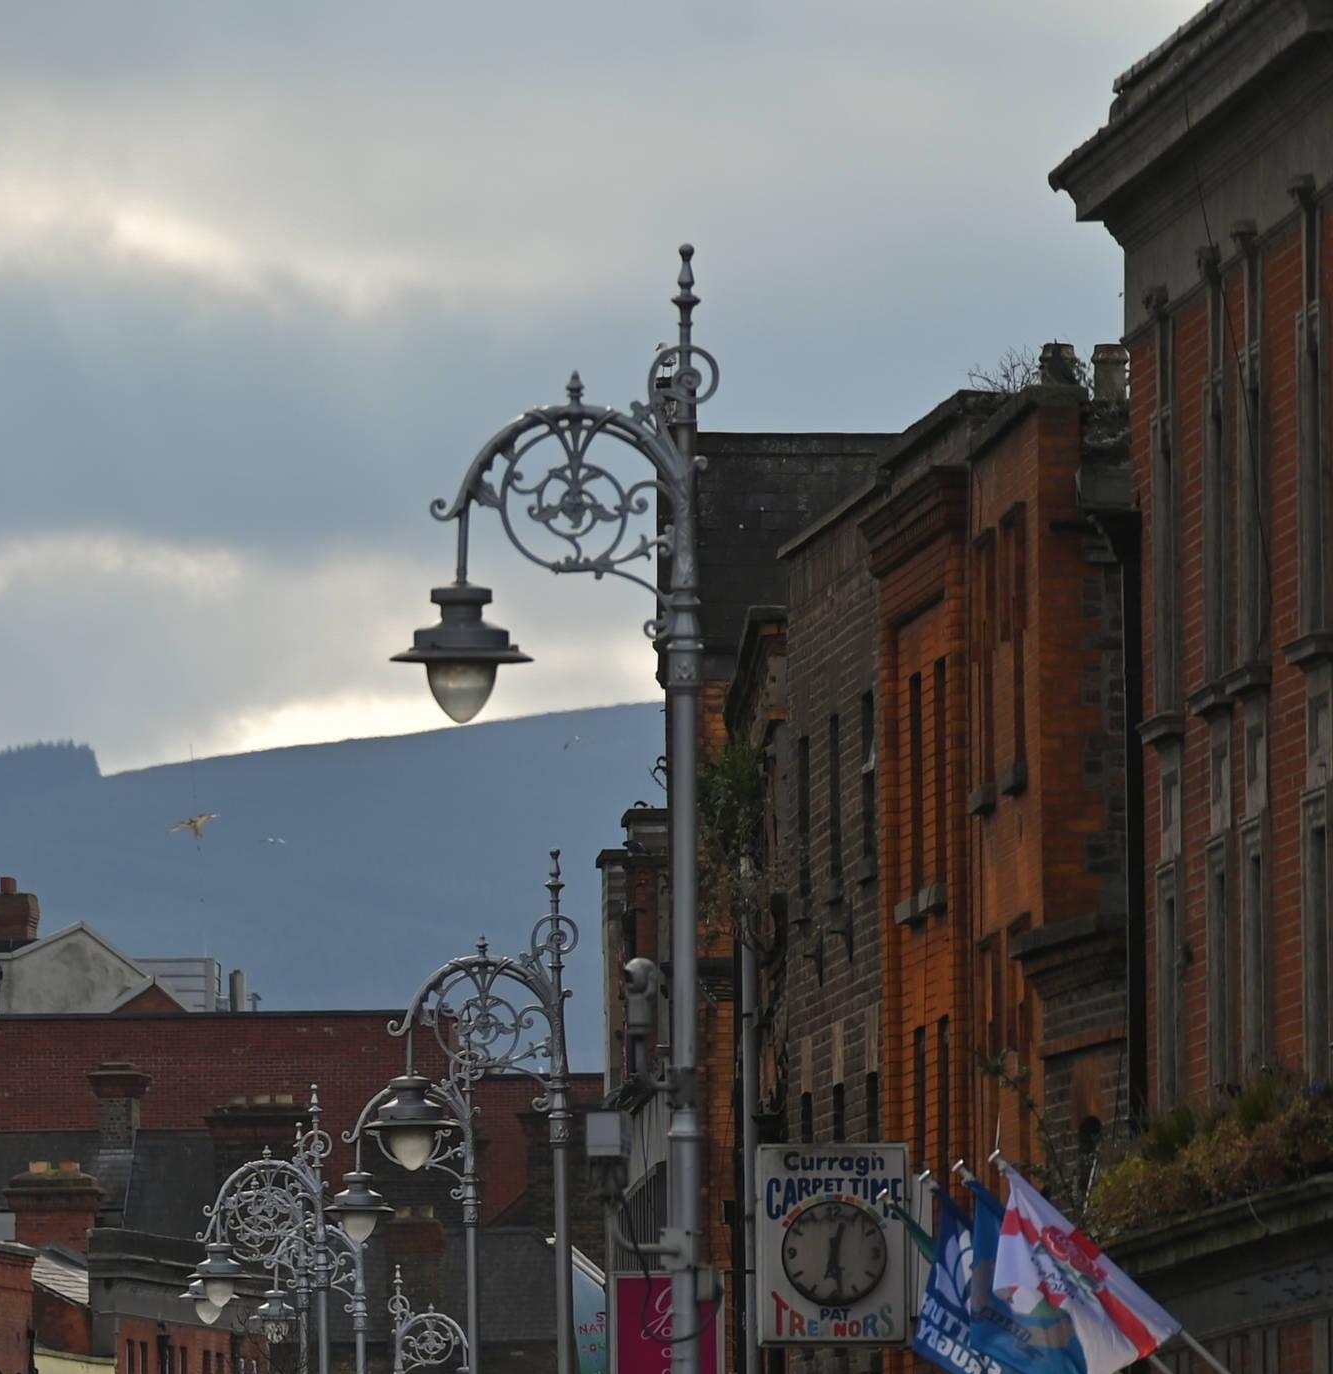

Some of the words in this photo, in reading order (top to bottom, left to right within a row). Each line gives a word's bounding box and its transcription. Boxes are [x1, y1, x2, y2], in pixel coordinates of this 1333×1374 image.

[784, 1152, 885, 1175] Curragh
[766, 1178, 844, 1220] CARPET
[848, 1178, 902, 1220] TIME
[820, 1308, 851, 1321] PAT
